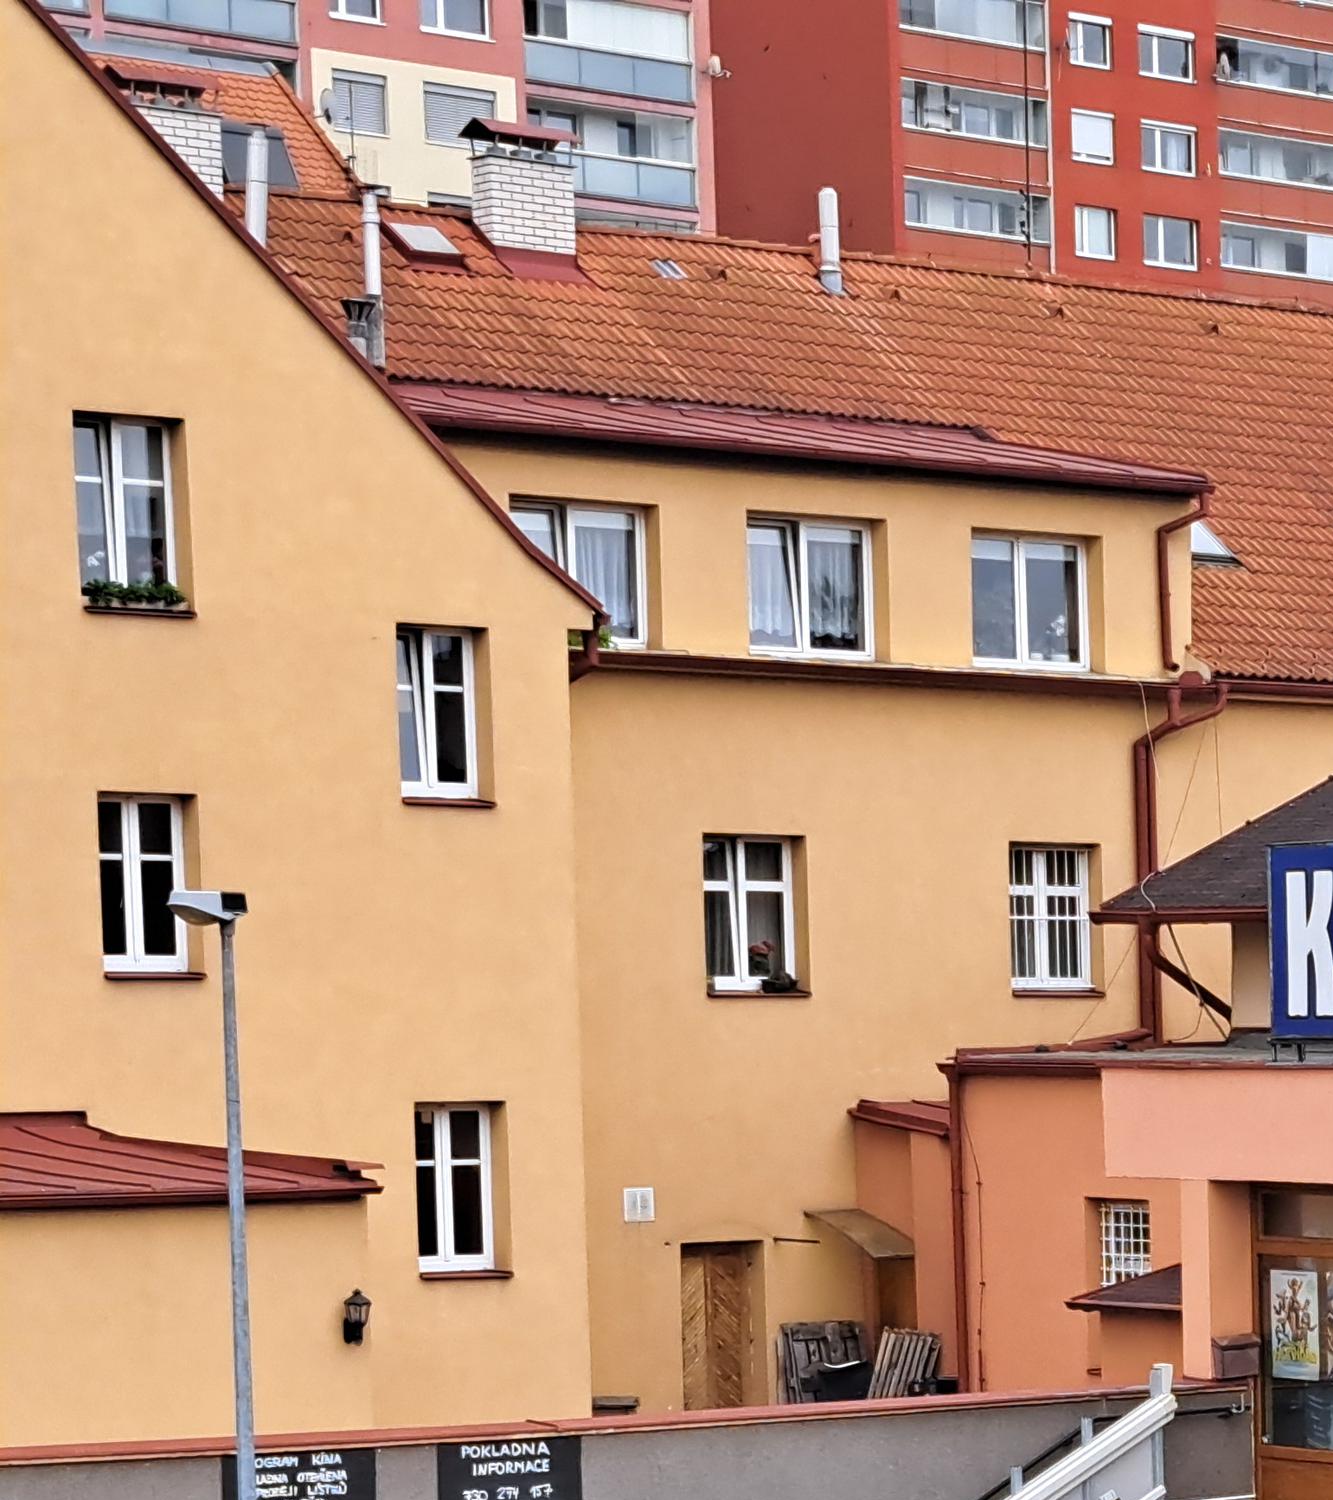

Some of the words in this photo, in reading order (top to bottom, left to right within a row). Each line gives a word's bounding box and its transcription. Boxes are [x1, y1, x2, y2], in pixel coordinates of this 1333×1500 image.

[461, 1441, 550, 1459] POKLADNA
[255, 1456, 299, 1469] OGRAM
[472, 1458, 550, 1476] INFORMACE
